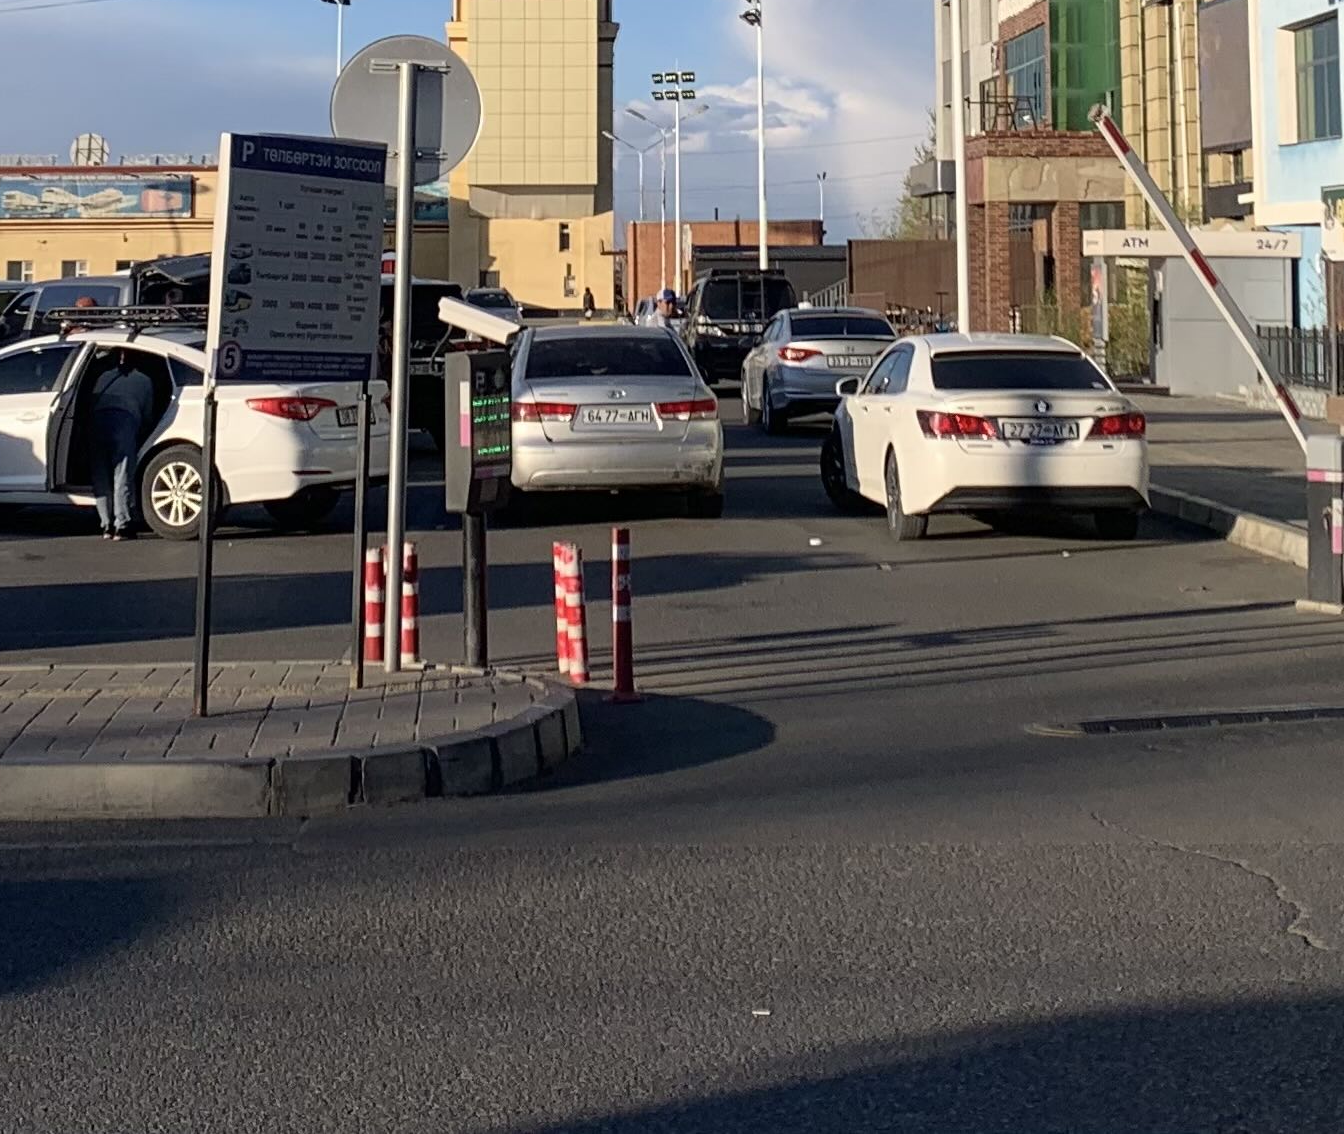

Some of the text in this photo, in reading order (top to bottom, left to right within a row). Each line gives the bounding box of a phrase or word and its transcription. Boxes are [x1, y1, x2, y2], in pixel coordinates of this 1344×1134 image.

[242, 141, 255, 162] P
[334, 155, 381, 173] ЗОГСООЛ
[1122, 238, 1149, 248] ATM
[1256, 239, 1288, 250] 24/7
[224, 346, 236, 367] 5
